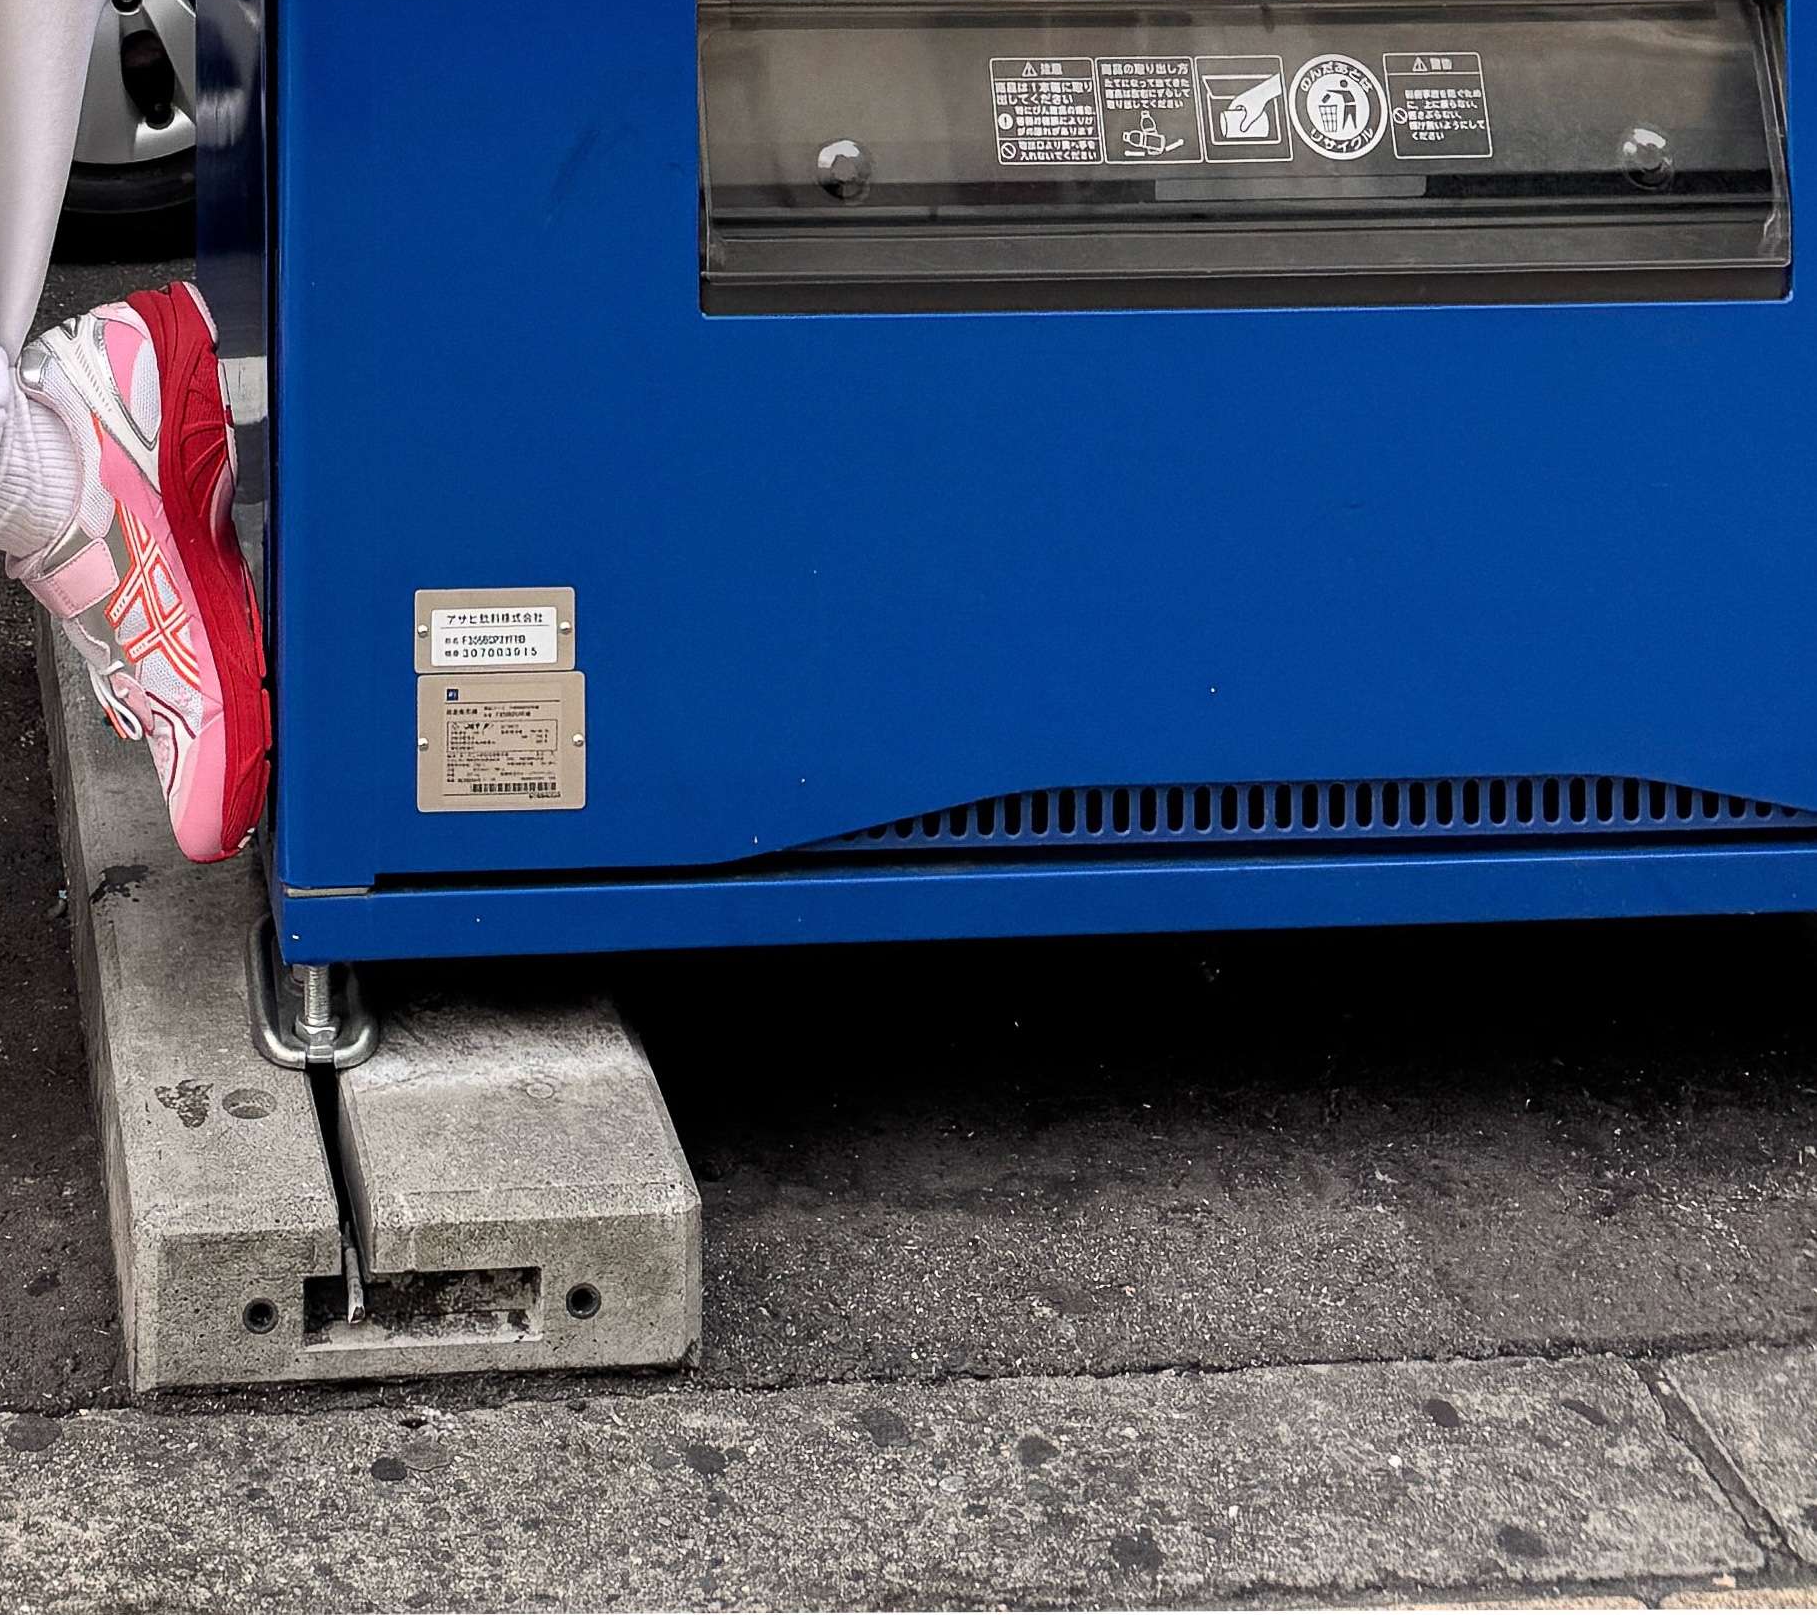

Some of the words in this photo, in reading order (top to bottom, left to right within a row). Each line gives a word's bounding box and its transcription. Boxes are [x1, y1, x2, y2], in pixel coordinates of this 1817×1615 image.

[1310, 127, 1374, 152] リサイクル
